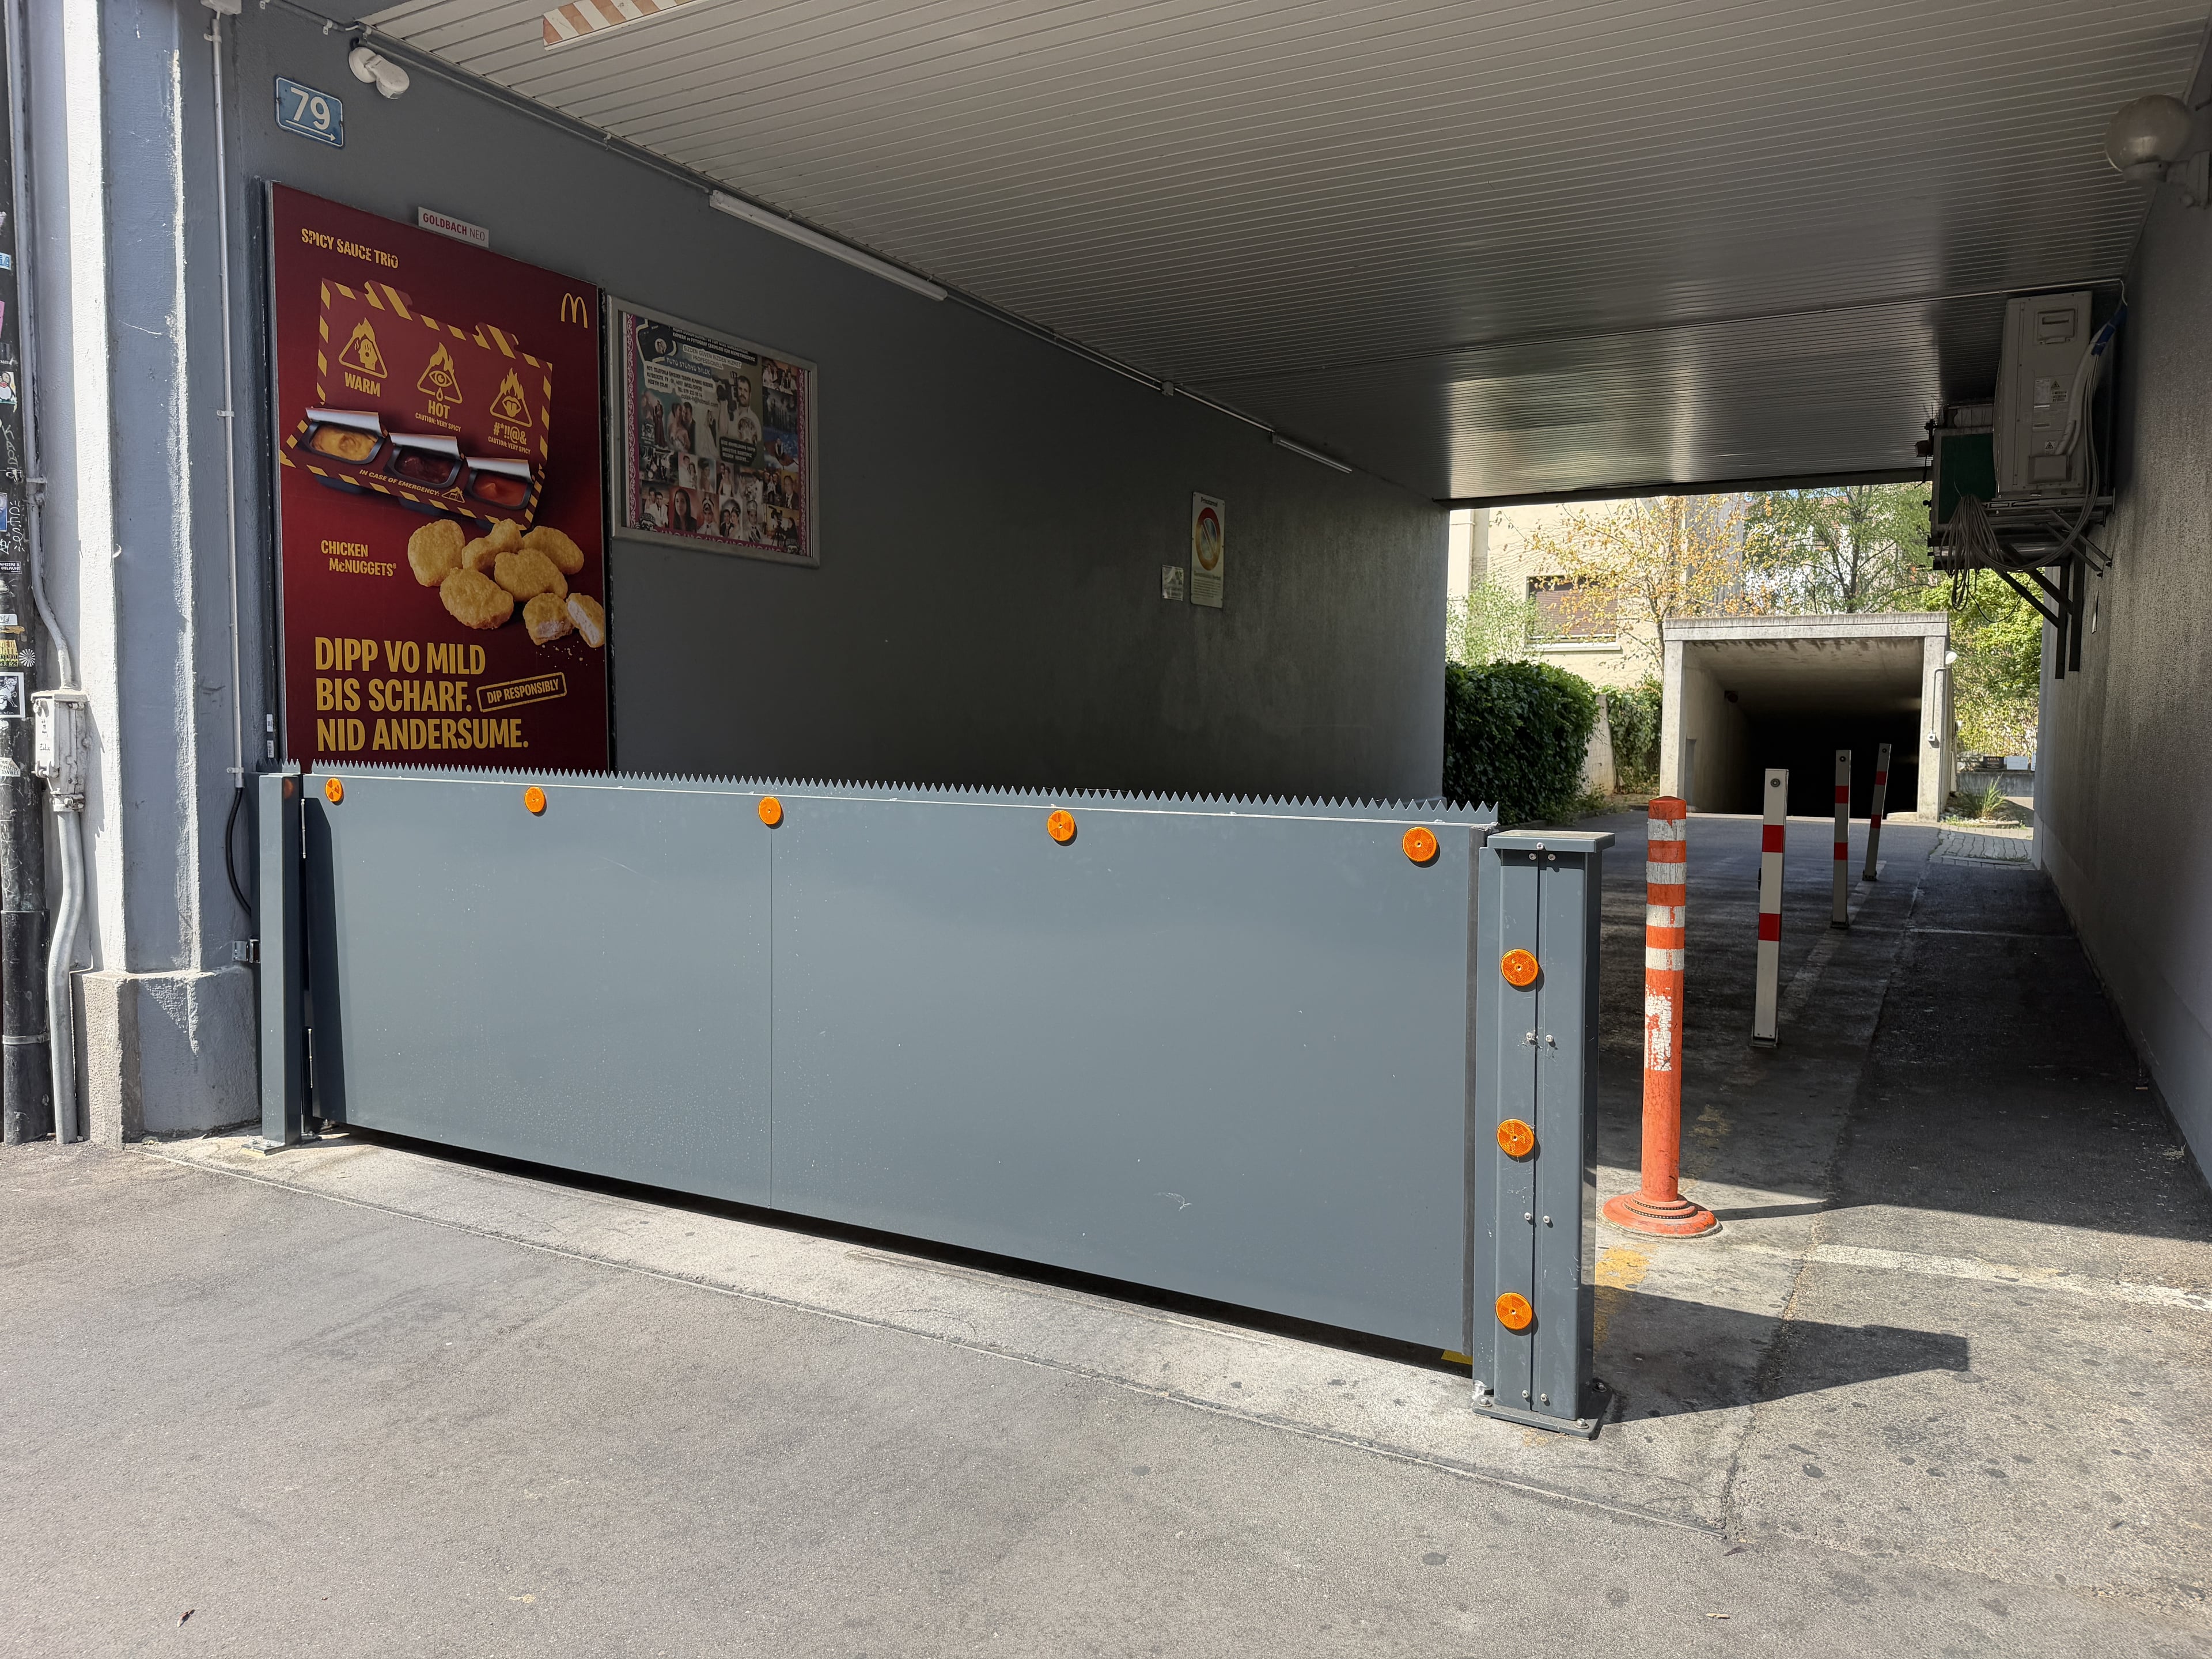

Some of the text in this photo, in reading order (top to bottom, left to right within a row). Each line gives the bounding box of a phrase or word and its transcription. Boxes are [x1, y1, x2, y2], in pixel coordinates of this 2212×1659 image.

[290, 86, 331, 130] 79
[423, 213, 485, 241] GOLDBACH NEO
[301, 228, 399, 269] SPICY SAUCE TRIO
[344, 372, 381, 397] WARM
[415, 412, 461, 433] CAUTION: VERY SPICY
[428, 400, 450, 419] HOT
[488, 435, 531, 455] CAUTION: VERY SPICY
[368, 471, 387, 482] CASE
[398, 480, 440, 497] EMERGENCY:
[321, 540, 368, 558] CHICKEN
[315, 637, 486, 675] DIPP VO MILD
[316, 677, 472, 712] BIS SCHARF.
[487, 679, 559, 704] DIP RESPONSIBLY
[316, 718, 529, 752] NID ANDERSUME.
